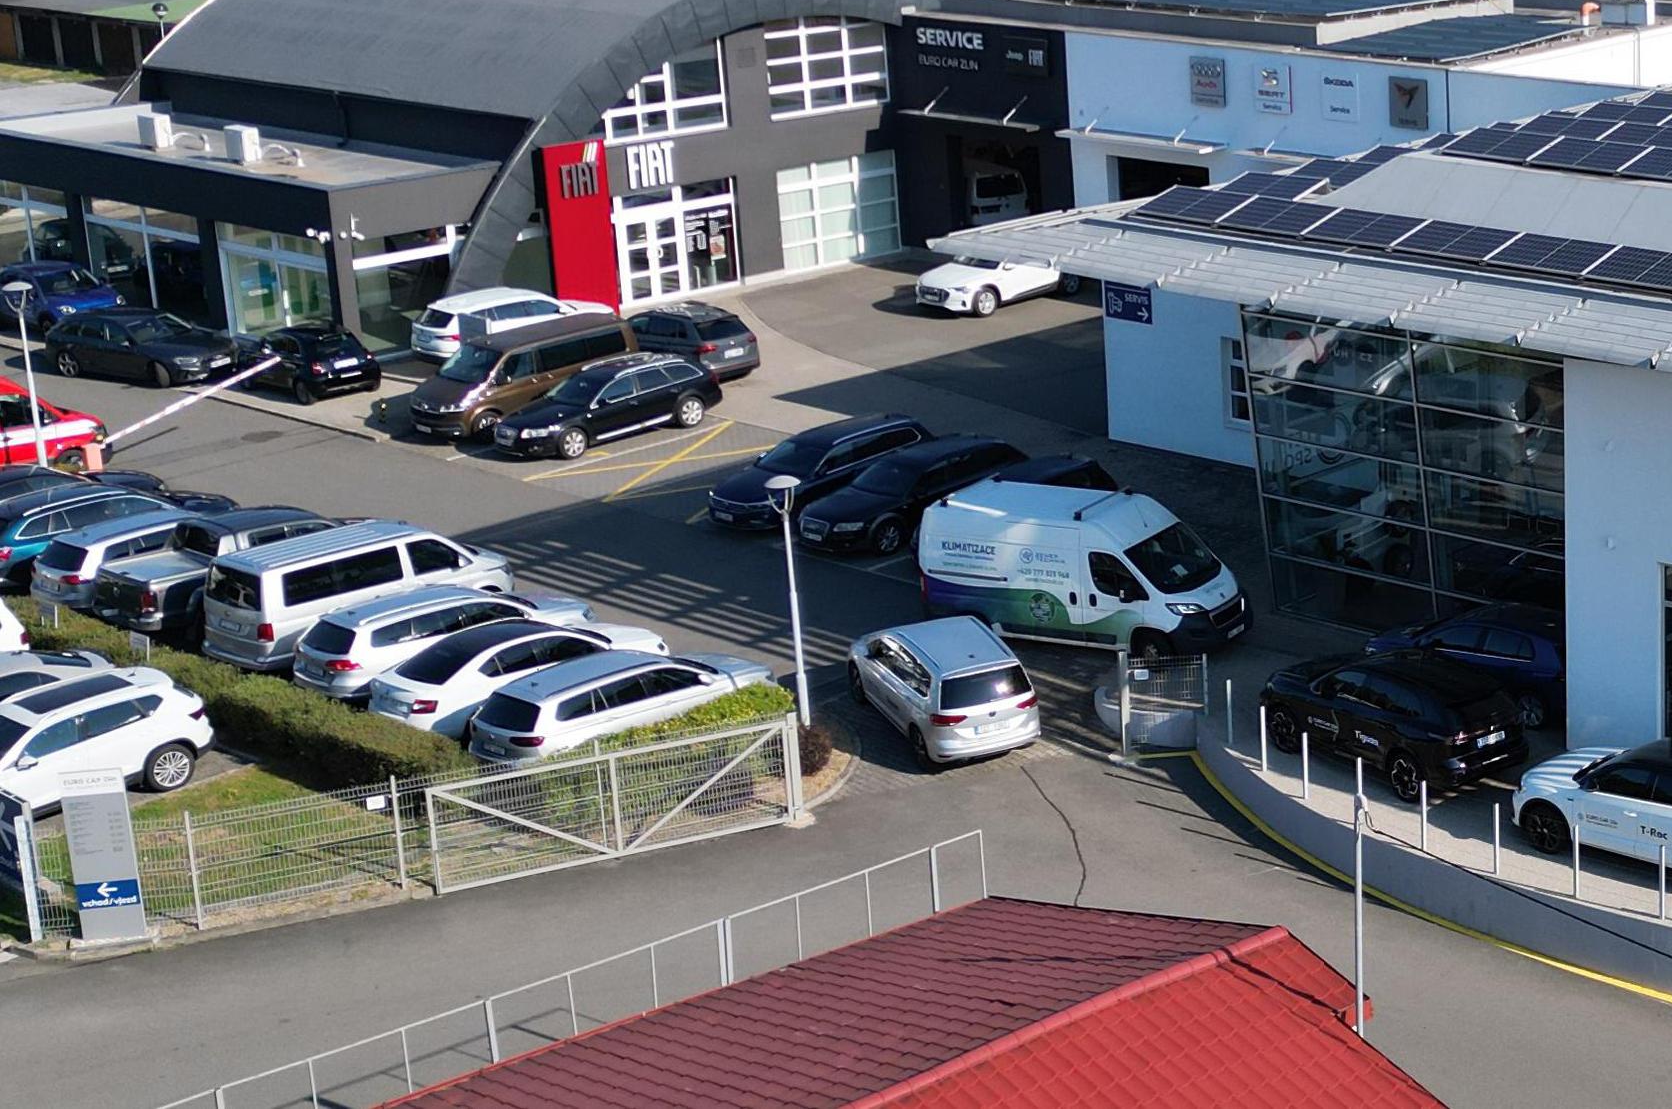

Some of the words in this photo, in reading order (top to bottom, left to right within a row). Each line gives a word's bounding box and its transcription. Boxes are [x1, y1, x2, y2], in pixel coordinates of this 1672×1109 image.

[916, 27, 984, 50] SERVICE
[918, 54, 941, 66] EURO
[942, 56, 959, 68] CAR
[1028, 49, 1044, 67] FIAT
[626, 140, 675, 190] FIAT
[560, 161, 599, 199] FIAT
[1124, 292, 1149, 305] SERVIS
[941, 541, 997, 555] KLIMATIZACE
[1639, 825, 1668, 840] T-Roc
